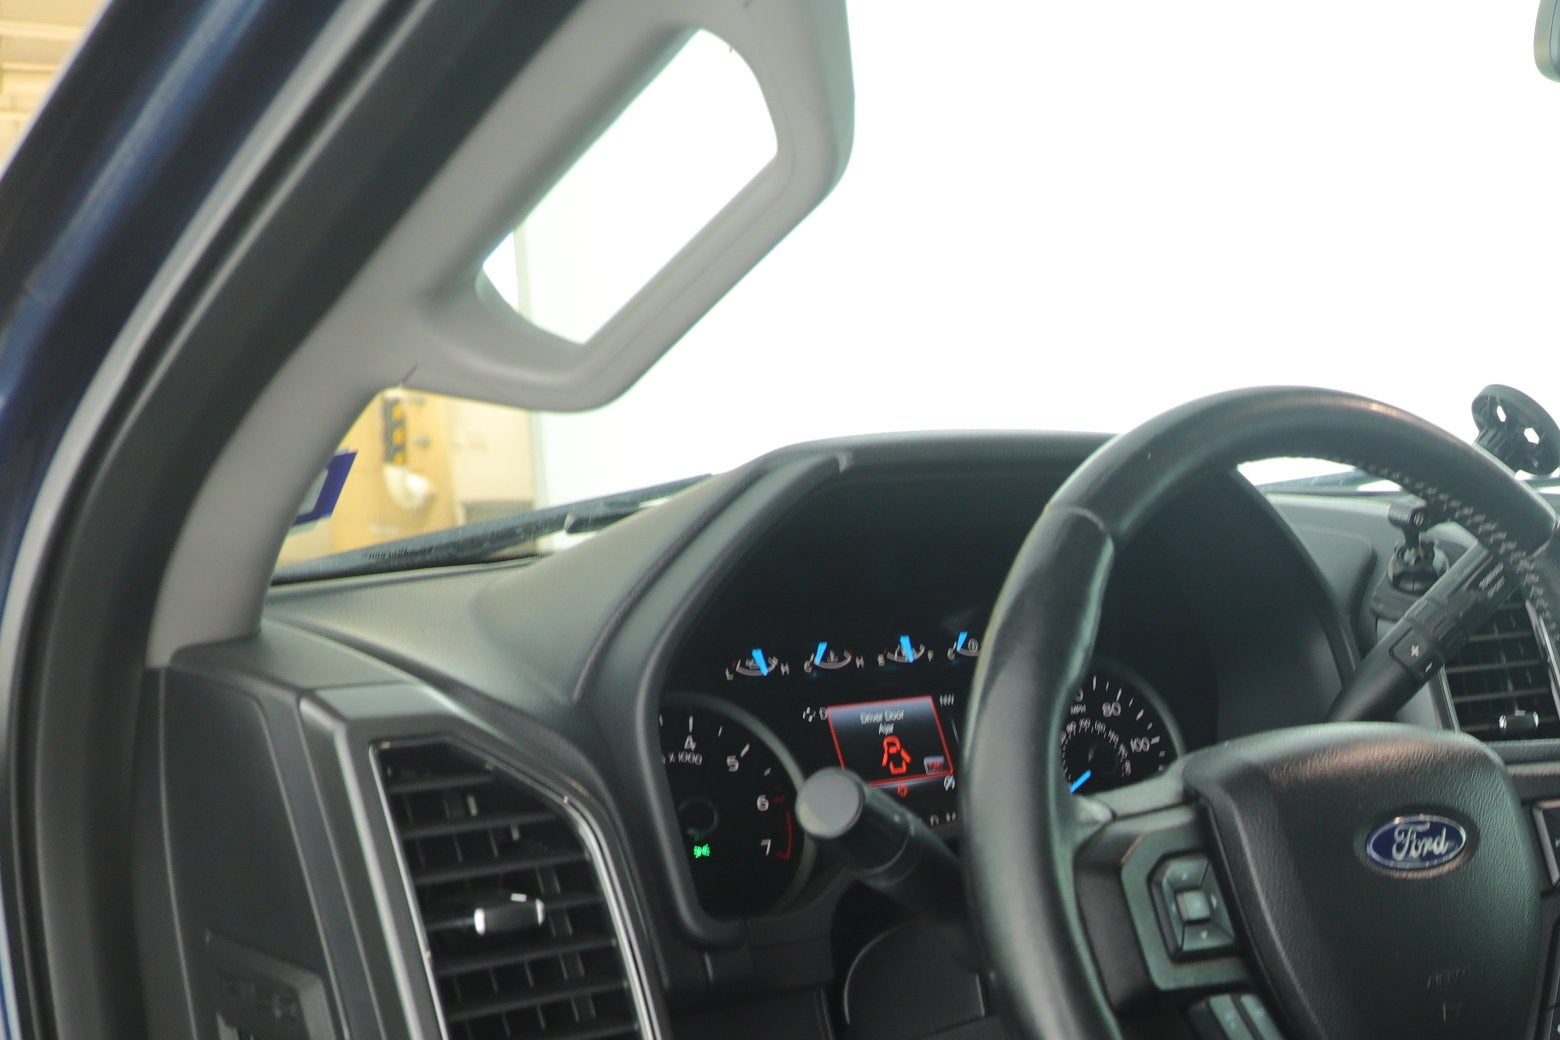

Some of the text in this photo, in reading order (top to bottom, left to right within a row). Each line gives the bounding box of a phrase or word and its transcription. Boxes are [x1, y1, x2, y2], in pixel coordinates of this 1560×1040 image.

[1102, 702, 1121, 717] 80
[684, 735, 697, 751] 4
[1130, 737, 1151, 752] 100
[726, 755, 739, 772] 5
[756, 795, 769, 811] 6
[761, 839, 771, 856] 7
[1392, 821, 1450, 860] Ford
